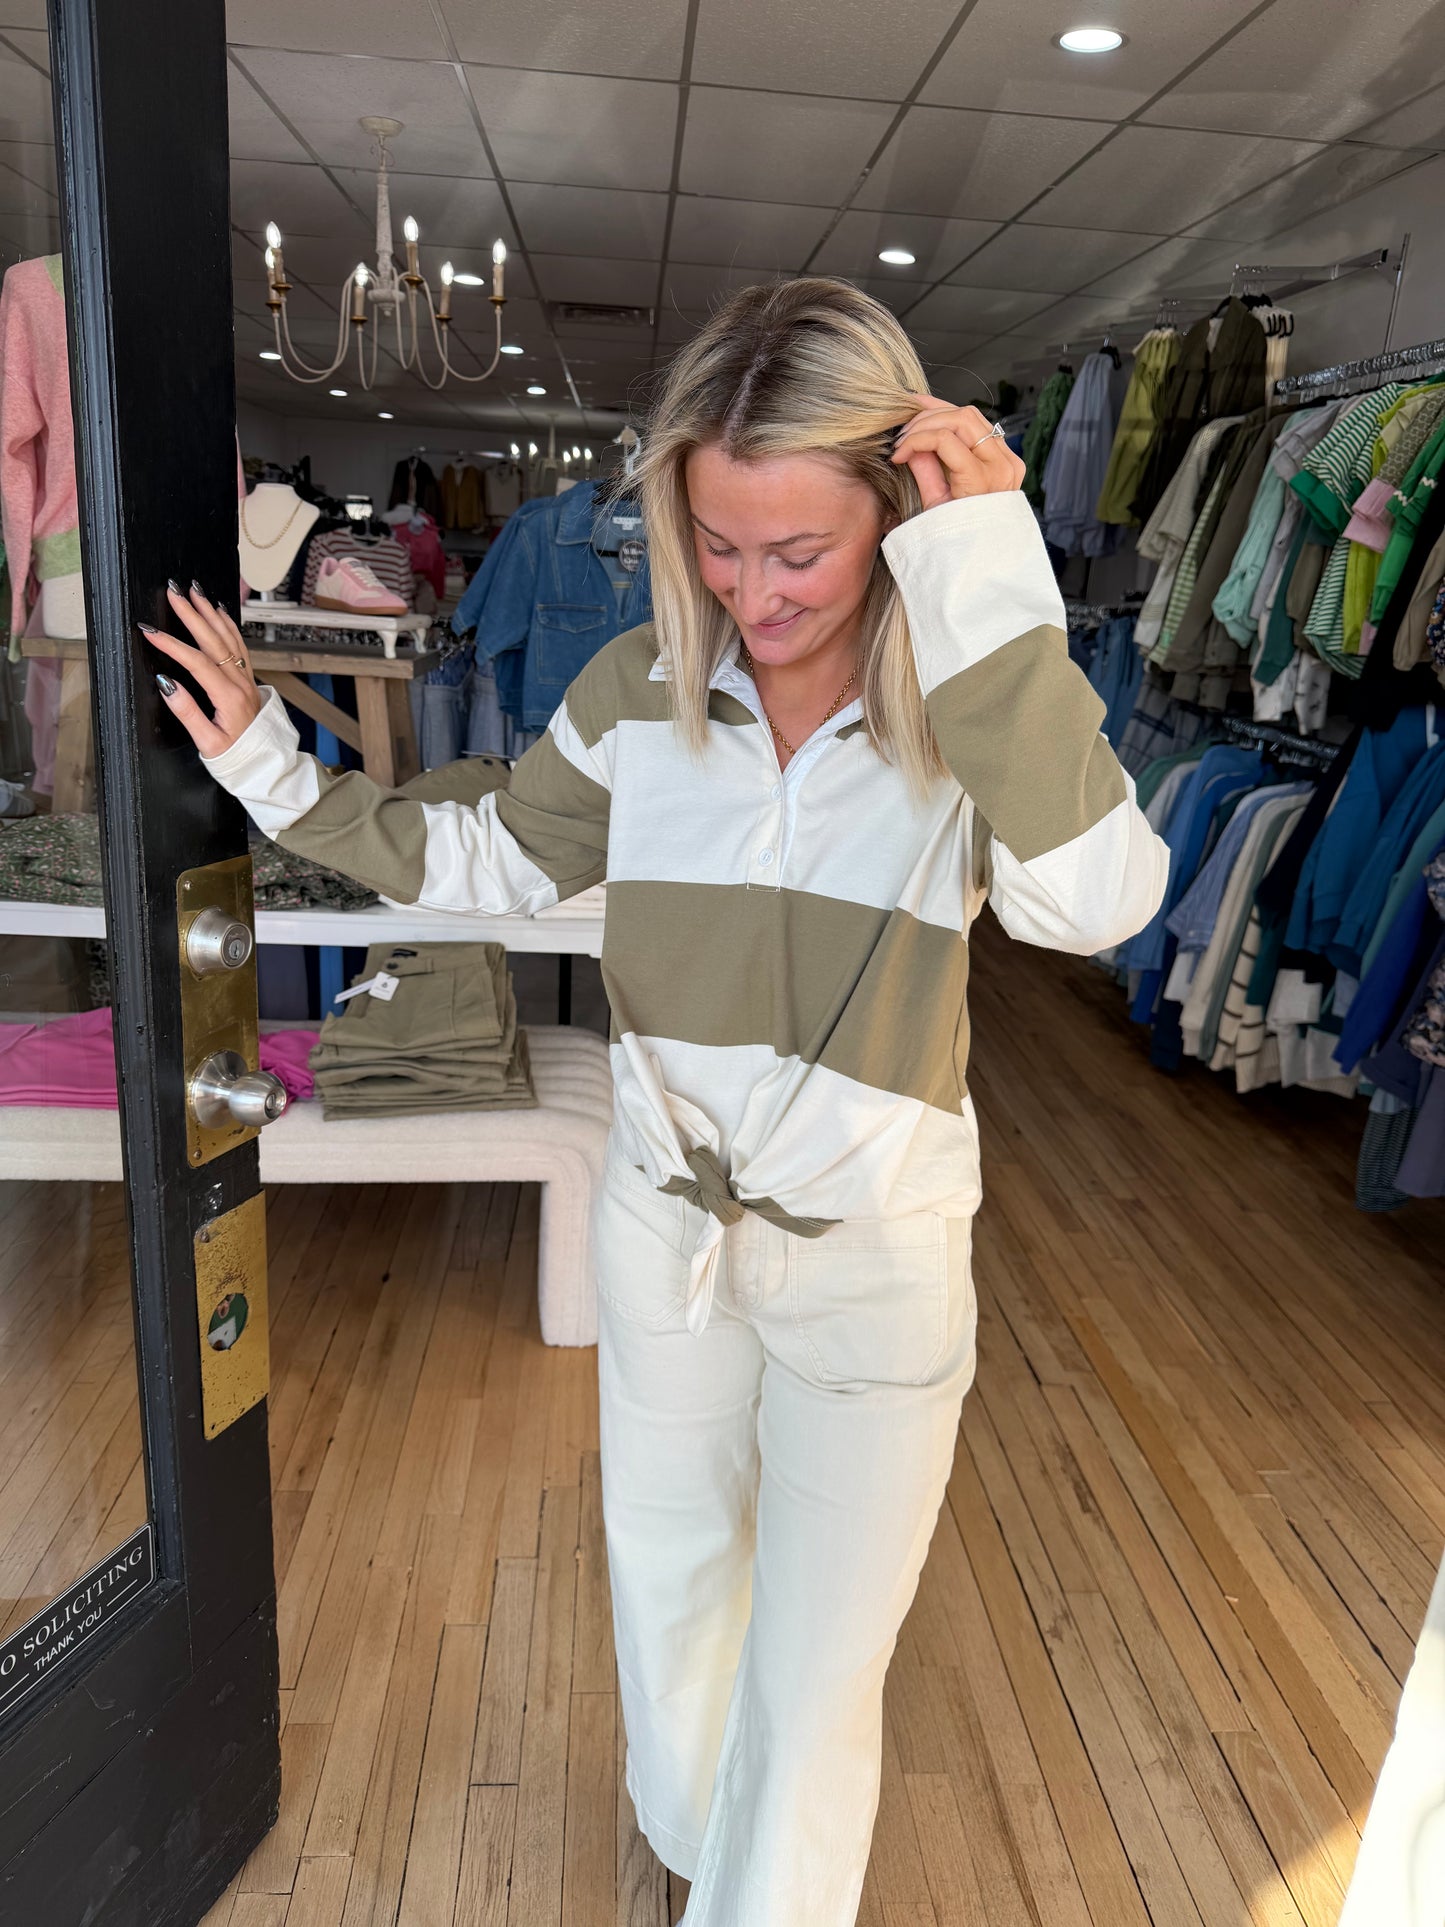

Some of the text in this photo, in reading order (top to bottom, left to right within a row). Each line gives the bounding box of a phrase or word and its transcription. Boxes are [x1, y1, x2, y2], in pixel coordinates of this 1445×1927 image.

[0, 1546, 143, 1676] O SOLICITING
[34, 1606, 102, 1671] THANK YOU
